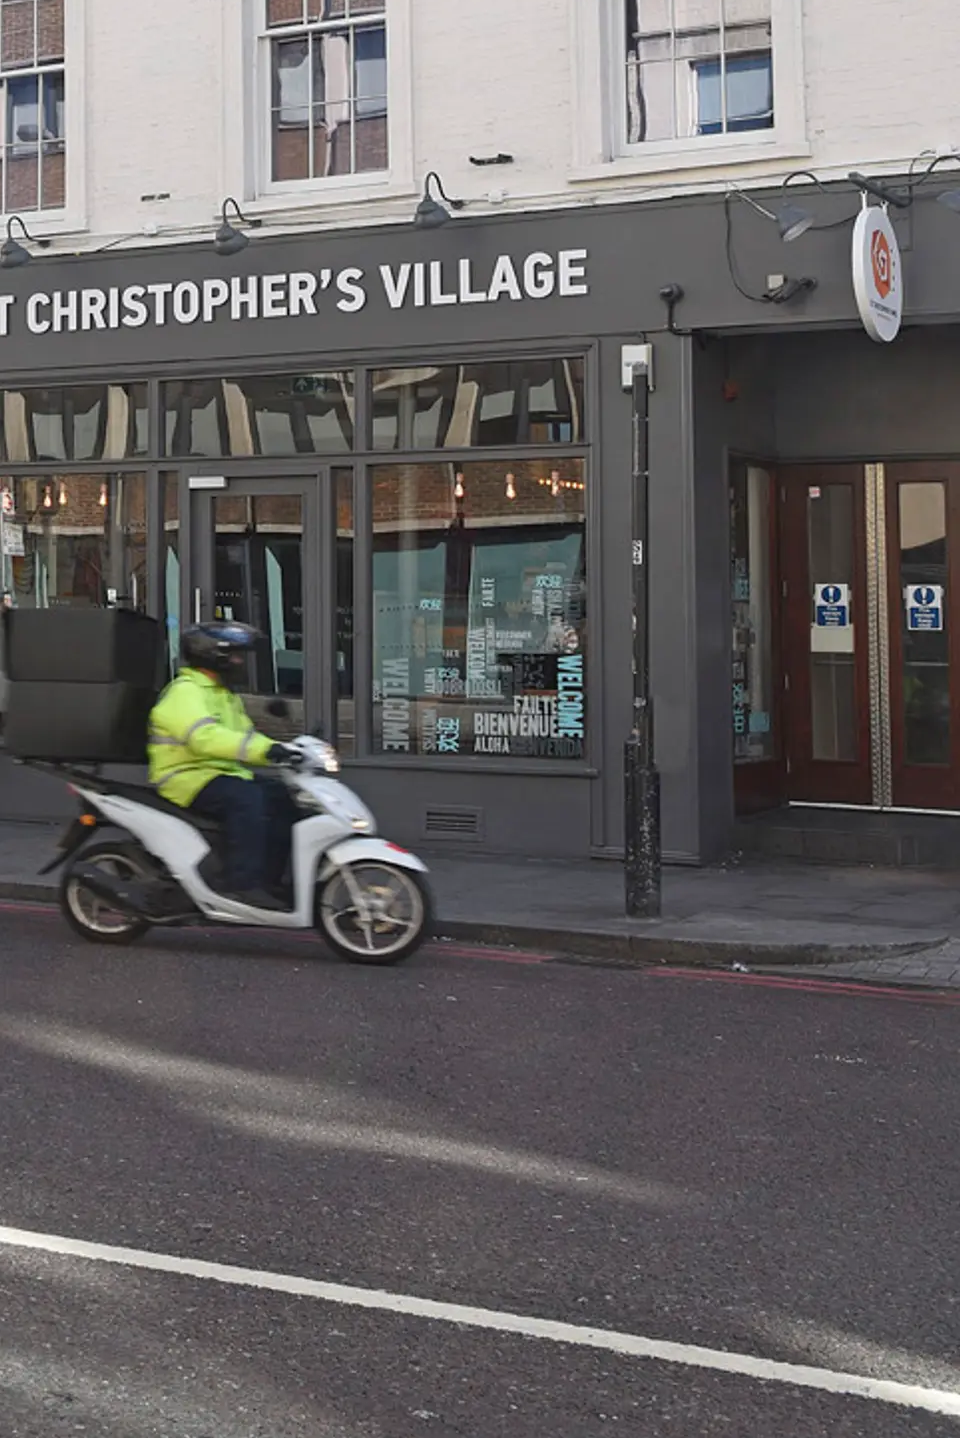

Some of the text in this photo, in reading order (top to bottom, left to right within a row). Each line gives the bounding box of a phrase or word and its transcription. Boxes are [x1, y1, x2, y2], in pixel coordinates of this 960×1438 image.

[26, 267, 366, 335] CHRISTOPHER'S
[379, 248, 589, 309] VILLAGE
[382, 658, 409, 751] WELCOME
[514, 694, 559, 715] FAILTE
[557, 654, 584, 739] WELCOME
[474, 712, 560, 739] BIENVENUE
[474, 736, 511, 754] ALOHA
